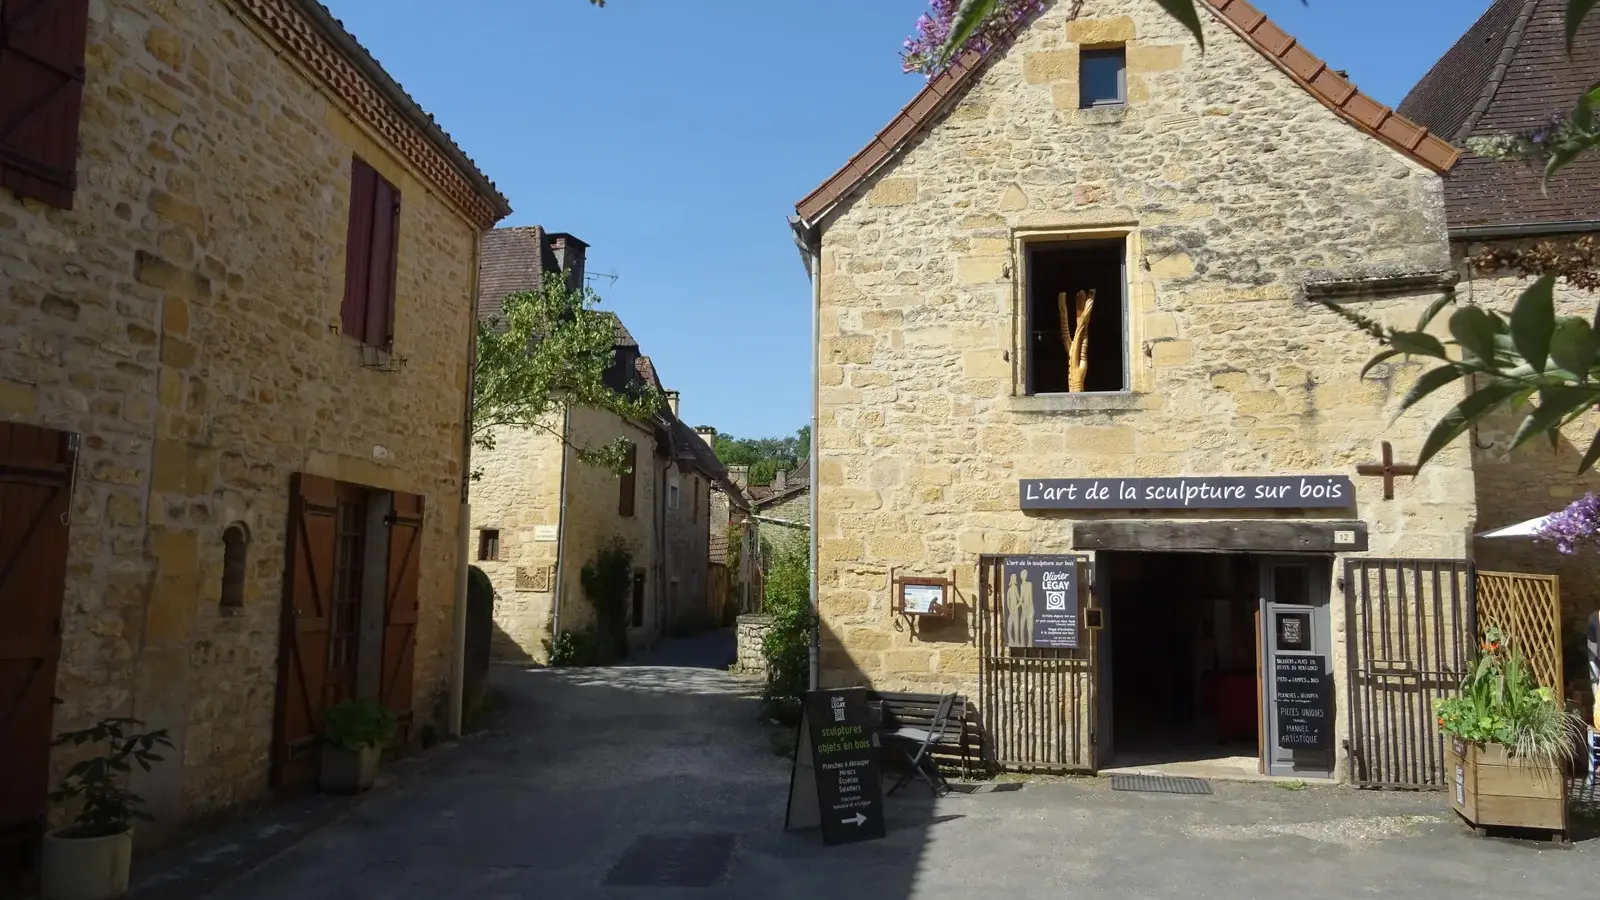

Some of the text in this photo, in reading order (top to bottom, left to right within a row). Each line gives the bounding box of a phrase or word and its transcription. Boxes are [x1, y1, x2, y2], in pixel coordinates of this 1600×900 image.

[1025, 478, 1343, 506] L'art de la sculpture sur bois
[1338, 533, 1349, 542] 12
[1042, 571, 1070, 581] Olivier
[1042, 582, 1070, 590] LEGAY
[821, 725, 862, 737] sculptures
[843, 742, 853, 750] en
[854, 740, 870, 750] bois
[822, 761, 844, 770] Planches
